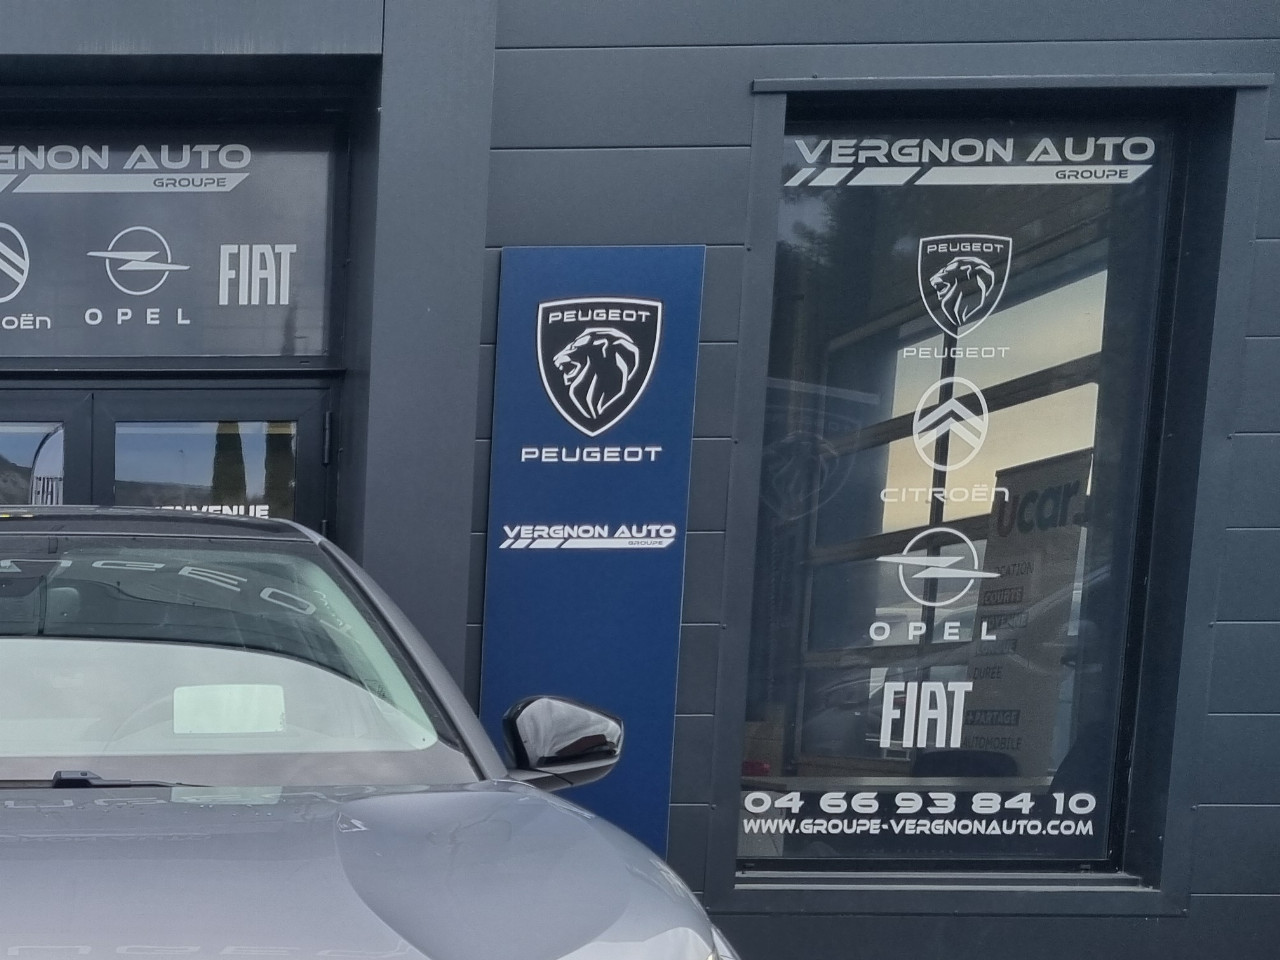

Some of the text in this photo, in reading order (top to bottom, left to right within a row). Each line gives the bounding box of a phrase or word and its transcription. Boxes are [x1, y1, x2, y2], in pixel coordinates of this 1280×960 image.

[122, 143, 253, 169] AUTO
[794, 136, 1156, 164] VERGNON AUTO
[152, 176, 227, 189] GROUPE
[1054, 168, 1129, 181] GROUPE
[926, 242, 1005, 254] PEUGEOT
[218, 244, 297, 306] FIAT
[84, 308, 191, 325] OPEL
[548, 309, 651, 324] PEUGEOT
[903, 345, 1011, 360] PEUGEOT
[521, 446, 663, 462] PEUGEOT
[502, 524, 677, 539] VERGNON AUTO
[868, 621, 997, 641] OPEL
[880, 681, 973, 749] FIAT
[743, 791, 1096, 815] 04 66 93 84 10
[743, 818, 1094, 836] WWW.GROUPE-VERGNONAUTO.COM
